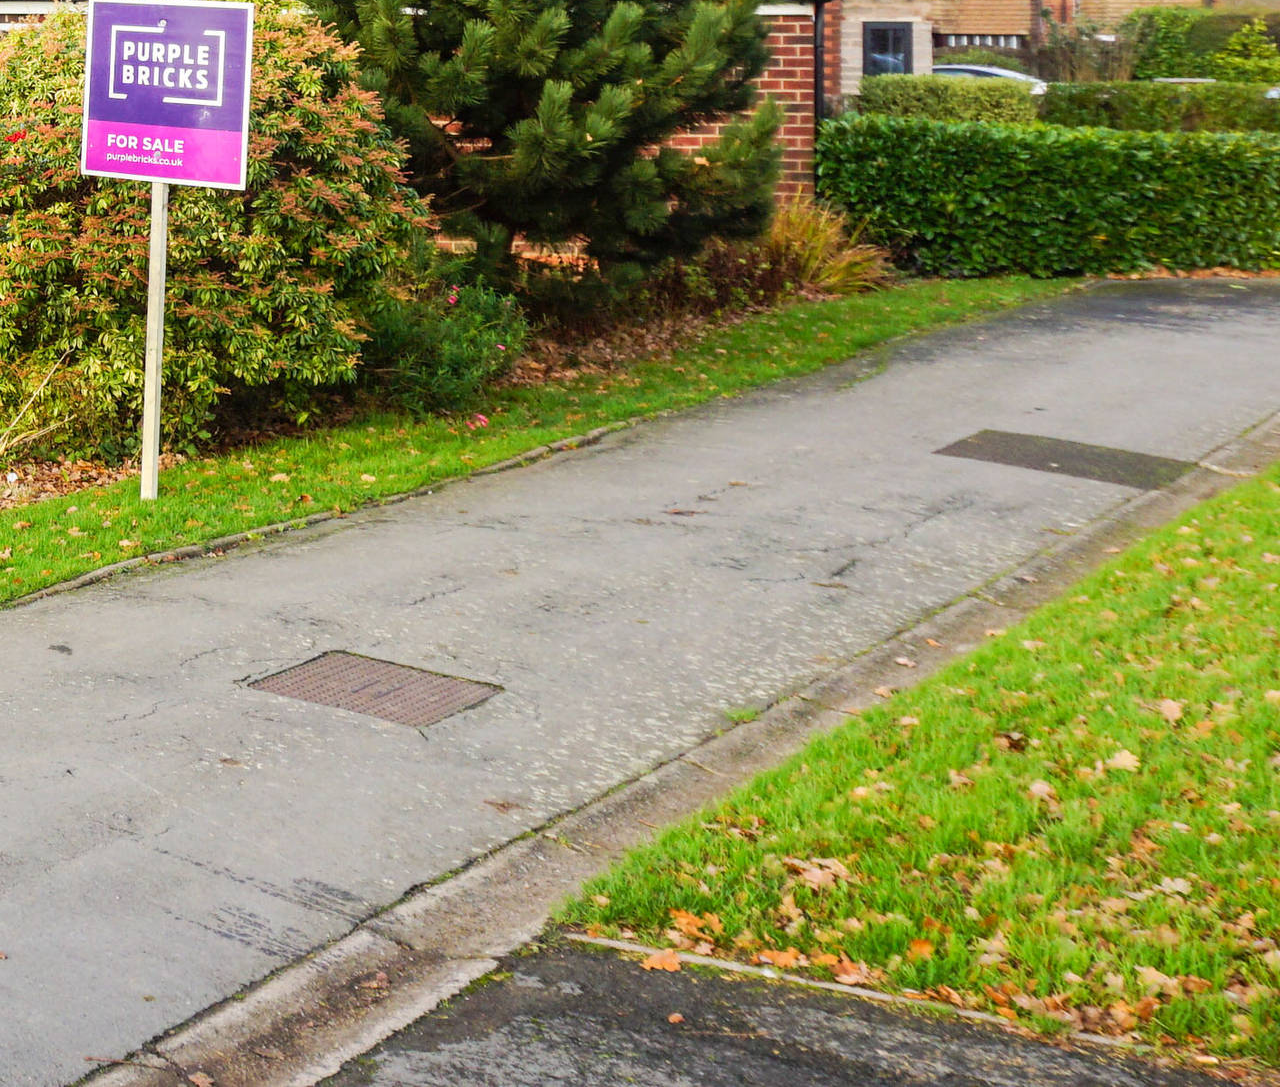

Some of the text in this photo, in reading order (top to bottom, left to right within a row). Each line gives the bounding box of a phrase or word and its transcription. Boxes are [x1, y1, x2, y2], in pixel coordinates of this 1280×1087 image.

[123, 41, 210, 65] PURPLE
[122, 64, 209, 89] BRICKS
[107, 133, 184, 153] FOR SALE
[106, 153, 183, 166] purplebricks.co.uk
